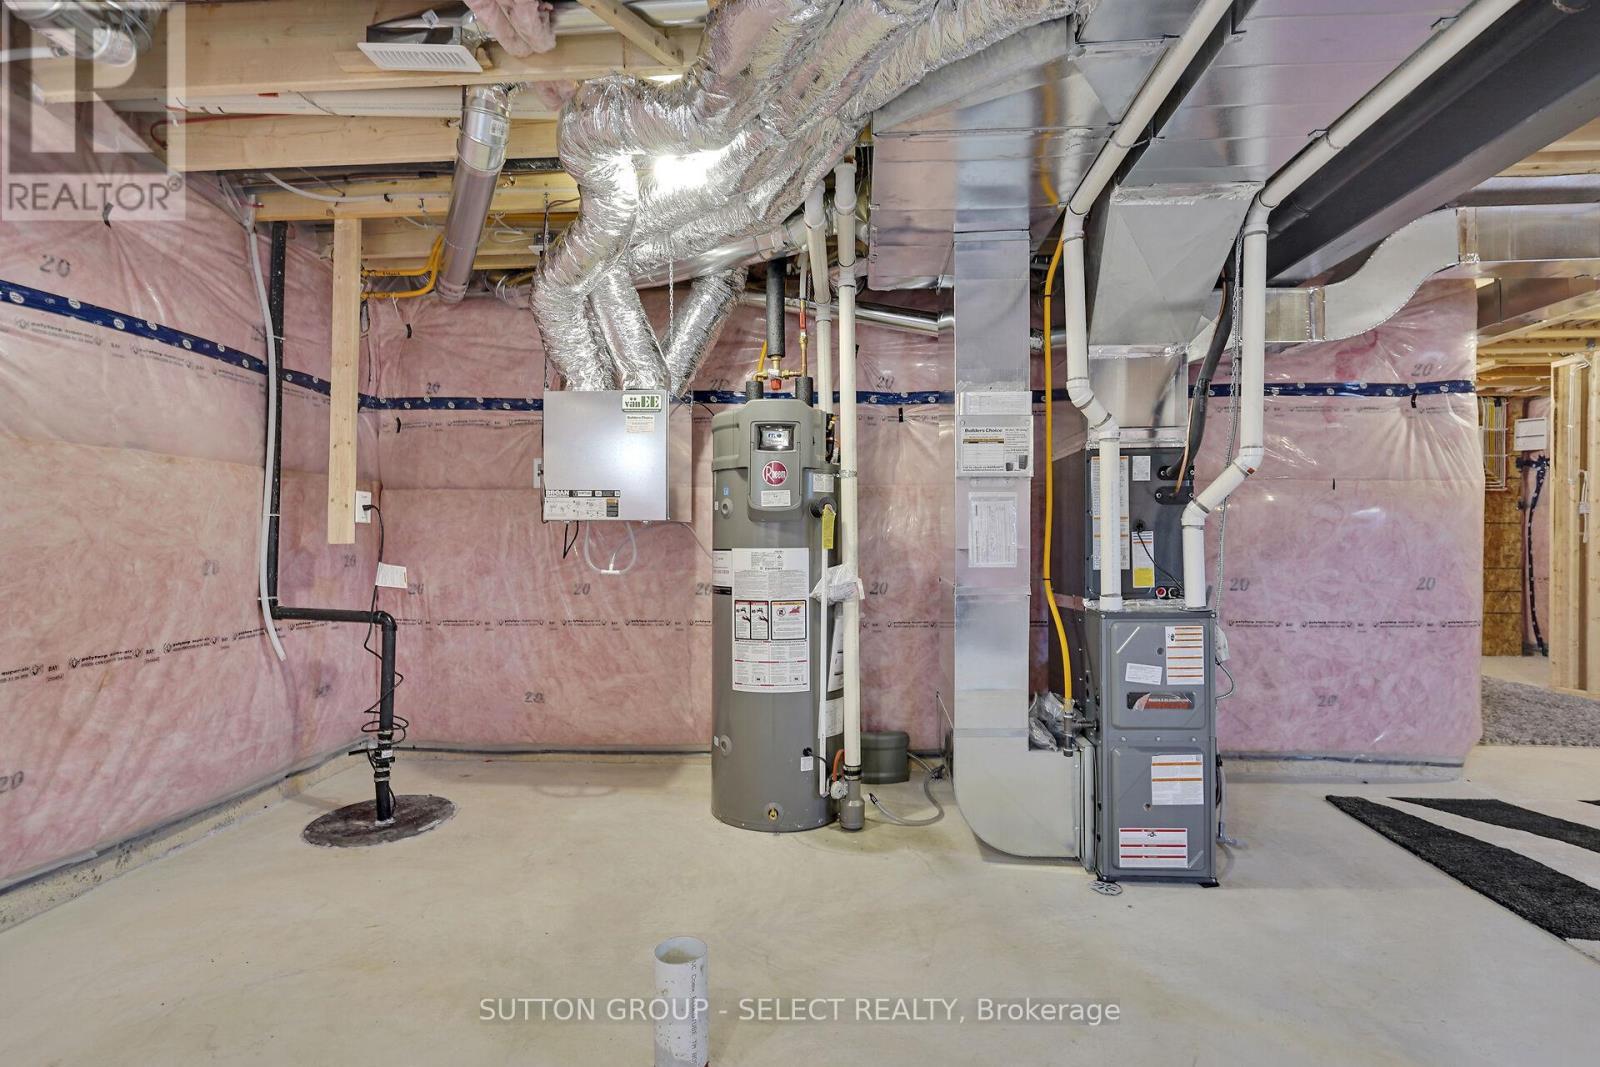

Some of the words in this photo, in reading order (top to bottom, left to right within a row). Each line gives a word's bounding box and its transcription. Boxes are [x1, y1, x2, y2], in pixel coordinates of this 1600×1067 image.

[39, 254, 71, 278] 20
[1411, 363, 1434, 377] 20
[426, 382, 440, 395] 20
[573, 583, 591, 596] 20
[869, 582, 888, 595] 20
[1229, 577, 1250, 592] 20
[1416, 577, 1436, 591] 20
